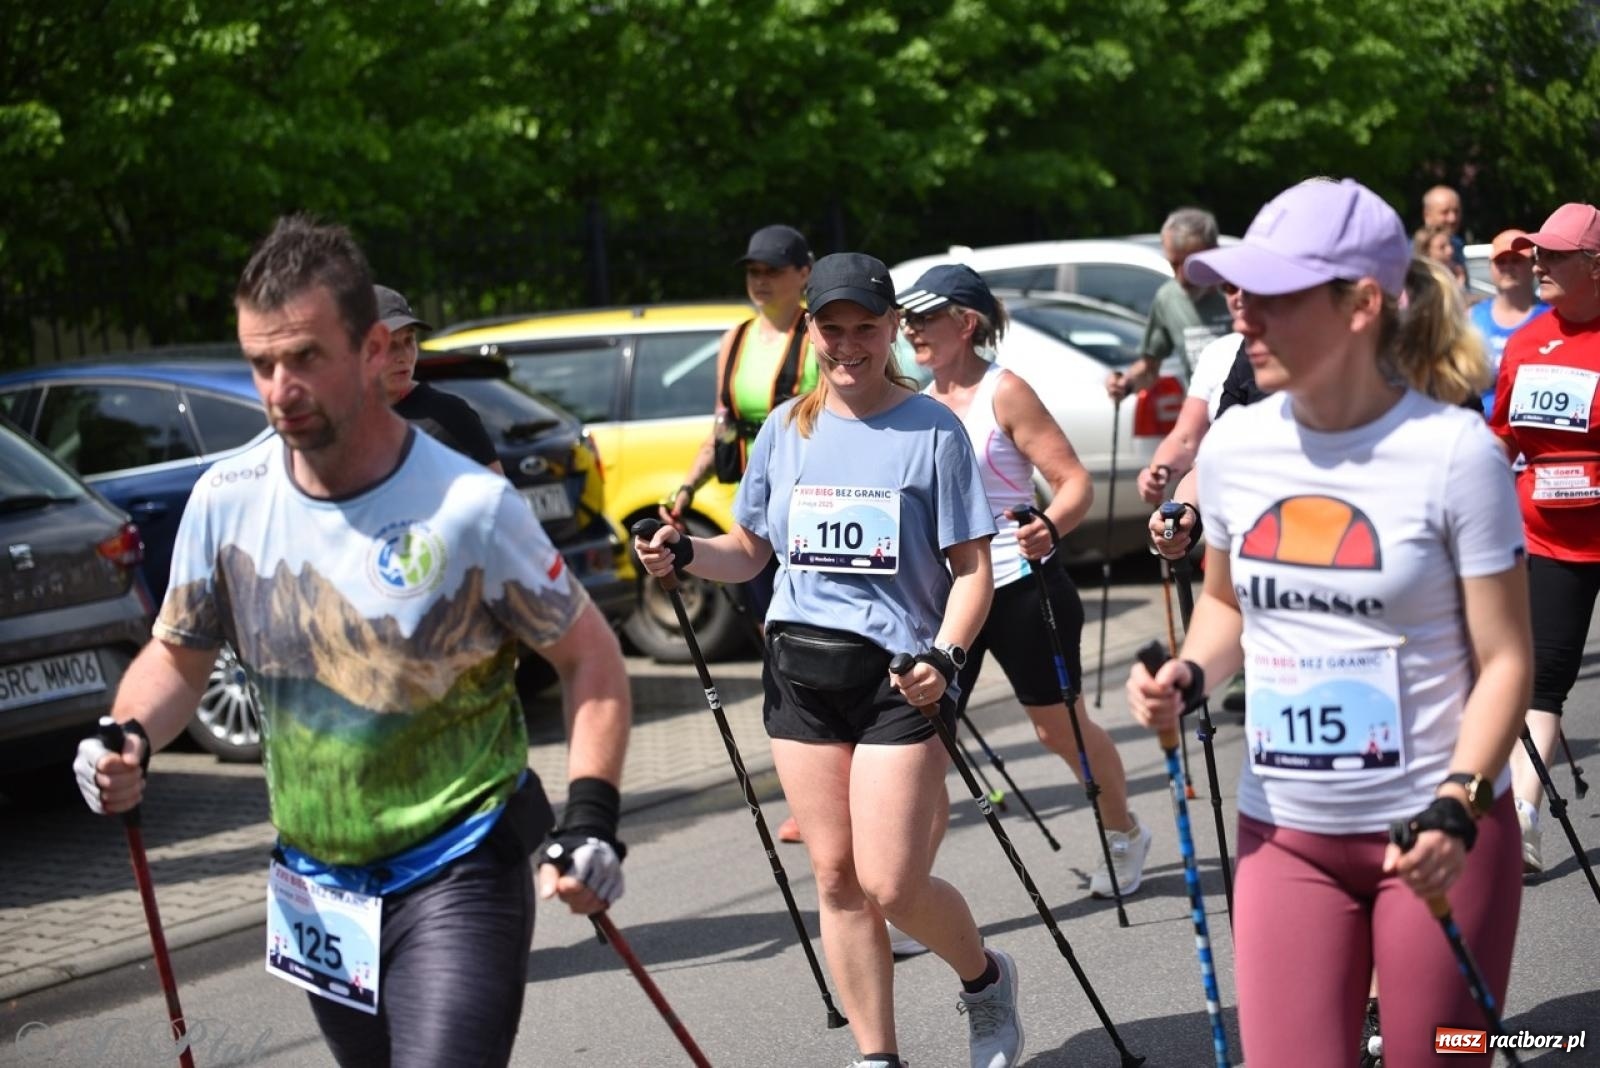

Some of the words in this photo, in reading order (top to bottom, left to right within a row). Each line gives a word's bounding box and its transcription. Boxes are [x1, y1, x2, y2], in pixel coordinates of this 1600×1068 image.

[1530, 390, 1569, 412] 109
[815, 488, 834, 496] BIEG
[835, 489, 852, 498] BEZ
[854, 489, 892, 499] GRANIC
[816, 520, 863, 550] 110
[42, 654, 98, 690] MM06
[1280, 704, 1346, 744] 115
[294, 921, 343, 970] 125
